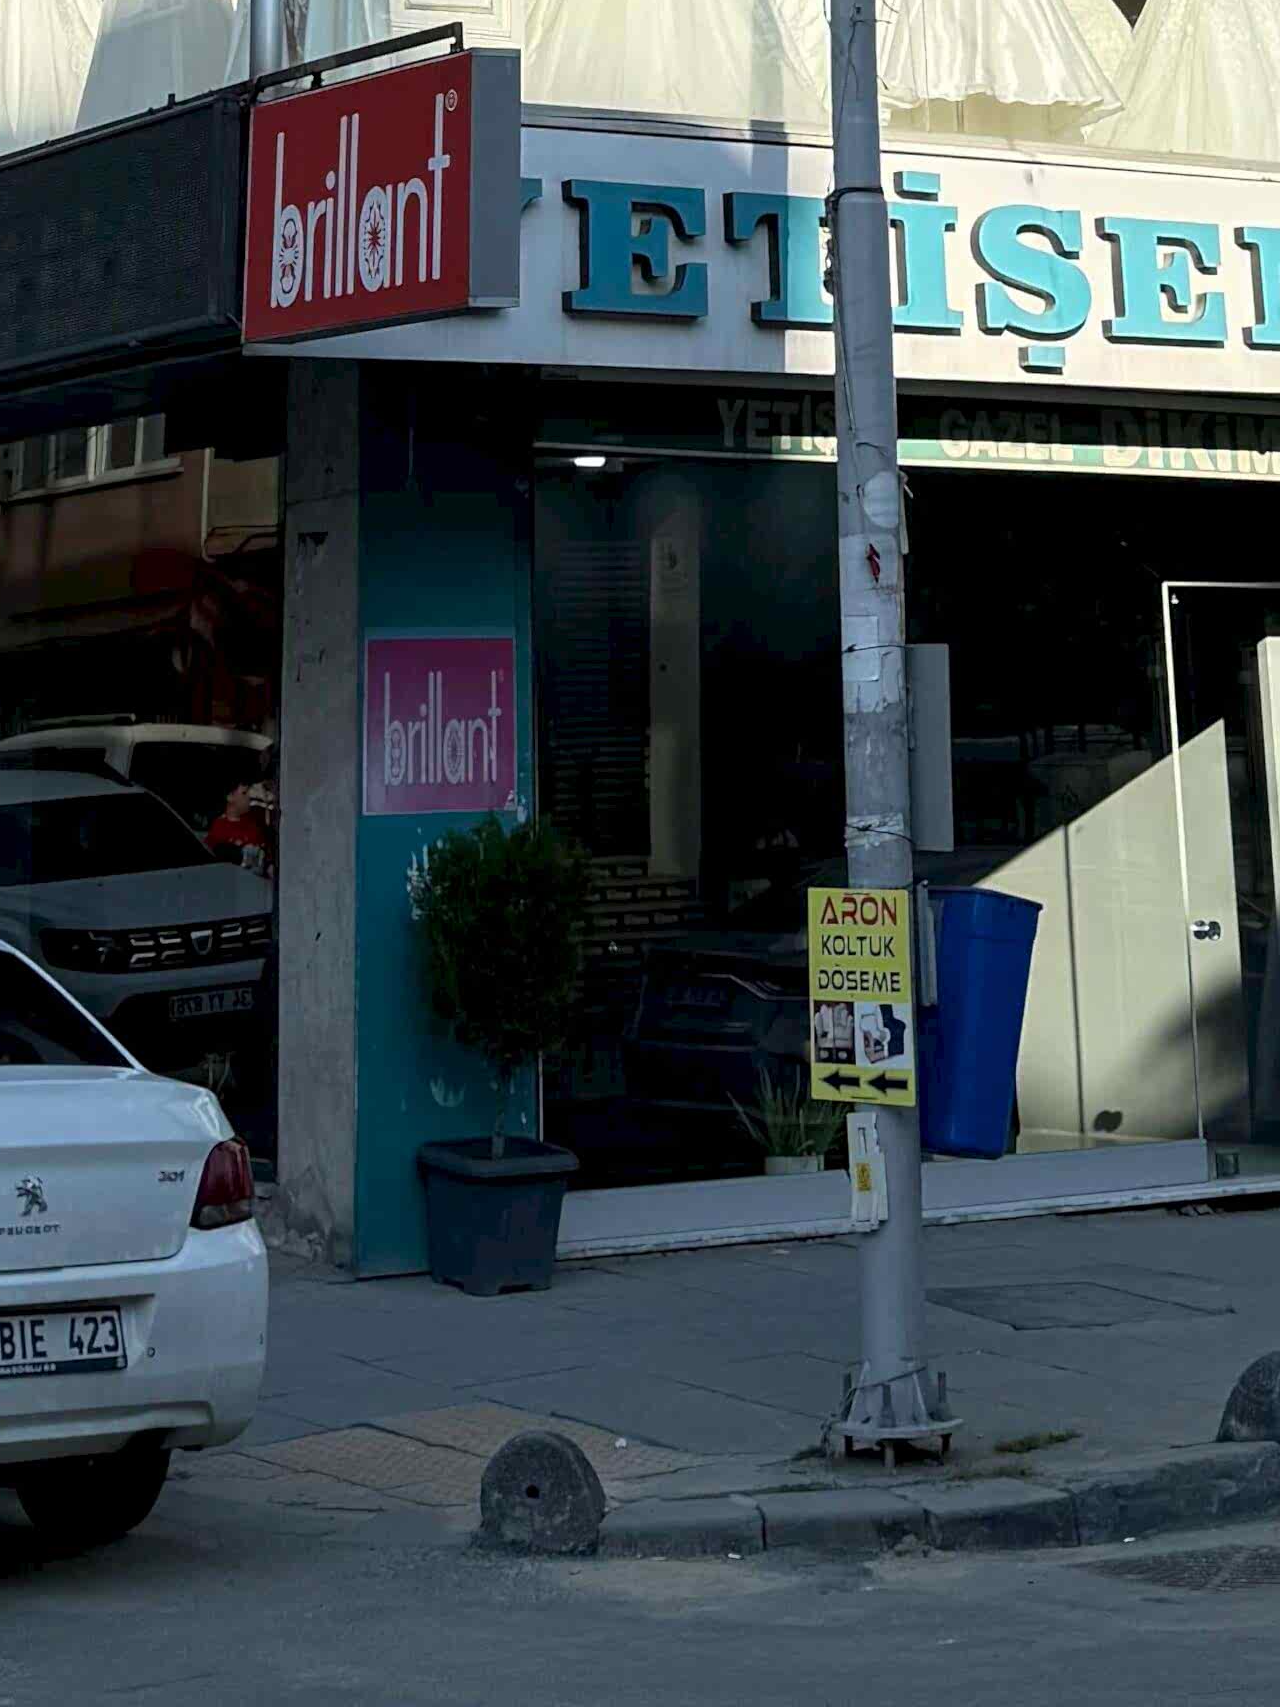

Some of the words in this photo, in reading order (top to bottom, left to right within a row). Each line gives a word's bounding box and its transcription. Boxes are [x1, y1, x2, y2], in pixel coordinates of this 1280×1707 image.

[269, 93, 451, 308] brillant
[939, 407, 1074, 463] GAZEL
[384, 669, 503, 786] brillant
[821, 895, 898, 926] ARON
[821, 934, 895, 957] KOLTUK
[69, 1315, 120, 1356] 423
